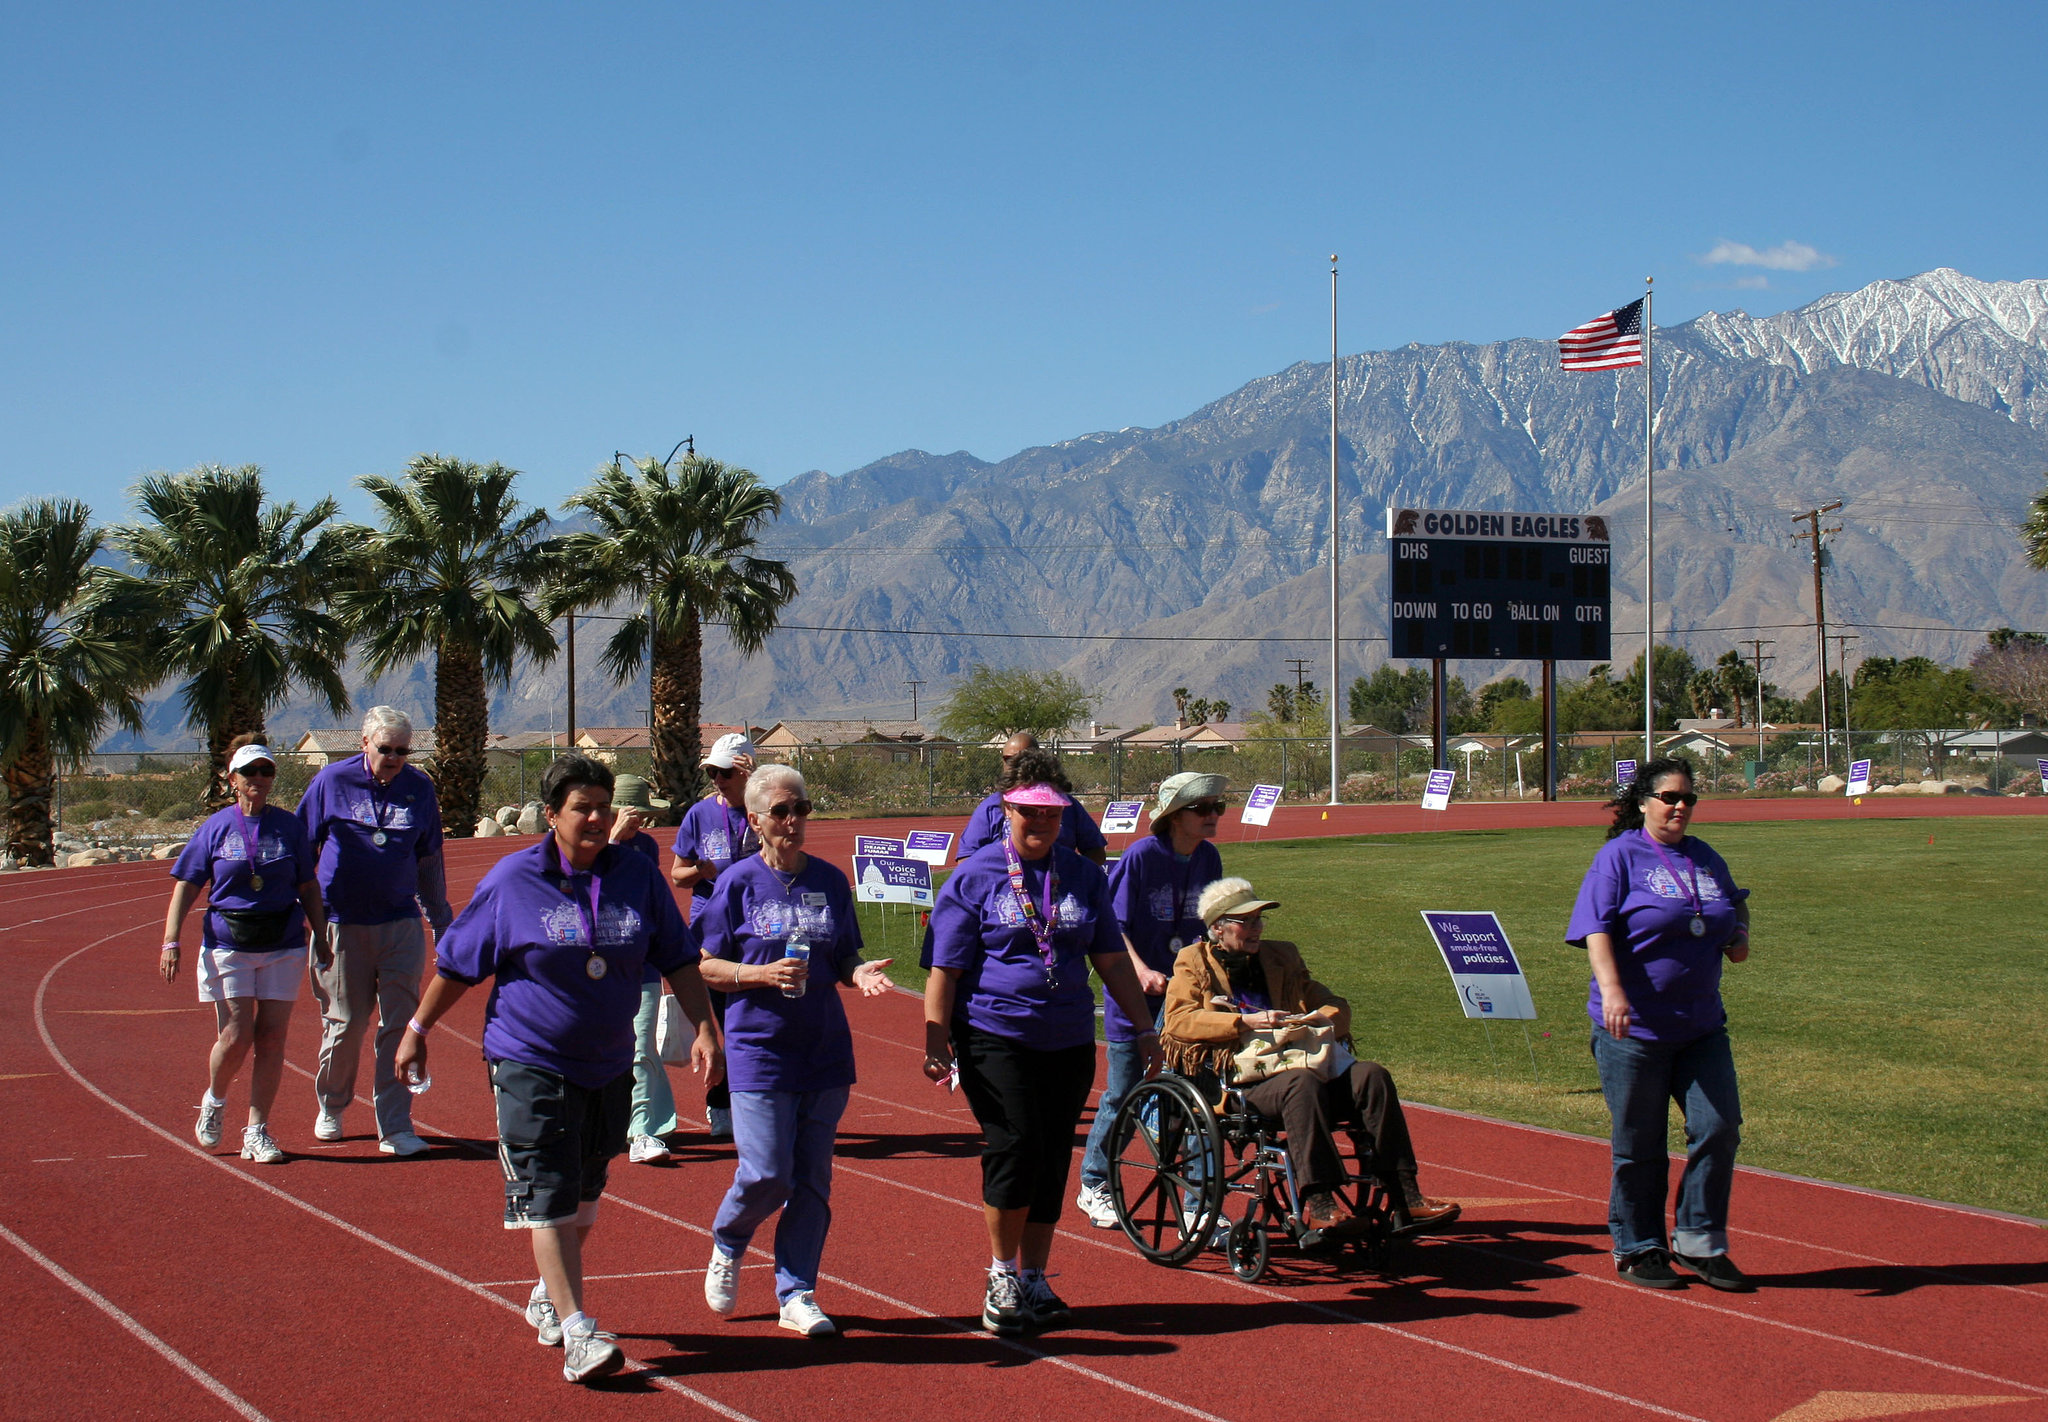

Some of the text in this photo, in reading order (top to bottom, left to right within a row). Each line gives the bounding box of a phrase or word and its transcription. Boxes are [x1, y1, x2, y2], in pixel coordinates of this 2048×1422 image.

[1424, 513, 1580, 539] GOLDEN EAGLES
[1400, 542, 1428, 559] DHS
[1569, 547, 1609, 564] GUEST
[1393, 602, 1437, 619] DOWN
[1451, 603, 1492, 620] TO GO
[1511, 604, 1559, 621] BALL ON
[1575, 605, 1602, 622] QTR
[888, 865, 916, 873] voice
[888, 873, 927, 886] Heard
[1437, 921, 1461, 933] We
[1452, 932, 1497, 944] support
[1450, 944, 1498, 952] smoke-free
[1462, 953, 1509, 965] policies.
